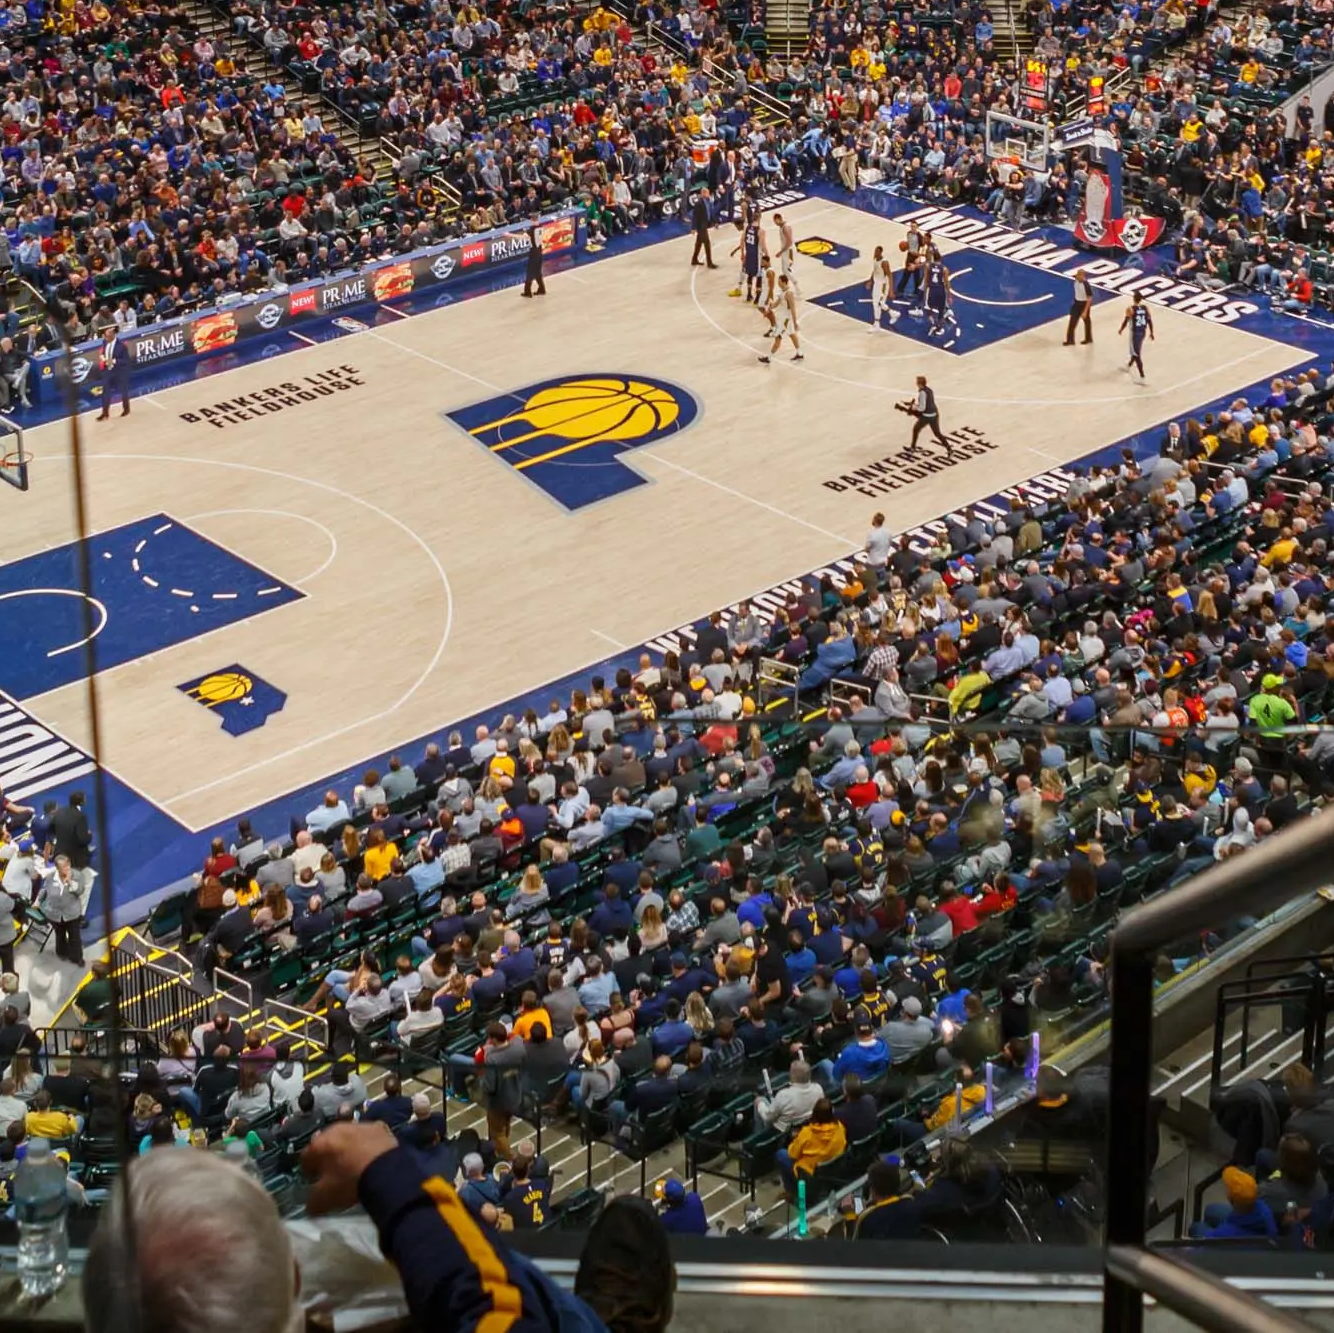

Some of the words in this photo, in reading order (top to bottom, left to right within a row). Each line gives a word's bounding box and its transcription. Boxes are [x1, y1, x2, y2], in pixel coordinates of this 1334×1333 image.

[463, 248, 484, 261] NEW!
[893, 206, 1080, 270] INDIANA
[1074, 259, 1260, 325] PACERS
[291, 295, 315, 309] NEW!
[179, 382, 302, 423] BANKERS
[303, 364, 360, 386] LIFE
[208, 376, 366, 428] FIELDHOUSE
[822, 445, 936, 493] BANKERS
[855, 438, 1000, 499] FIELDHOUSE
